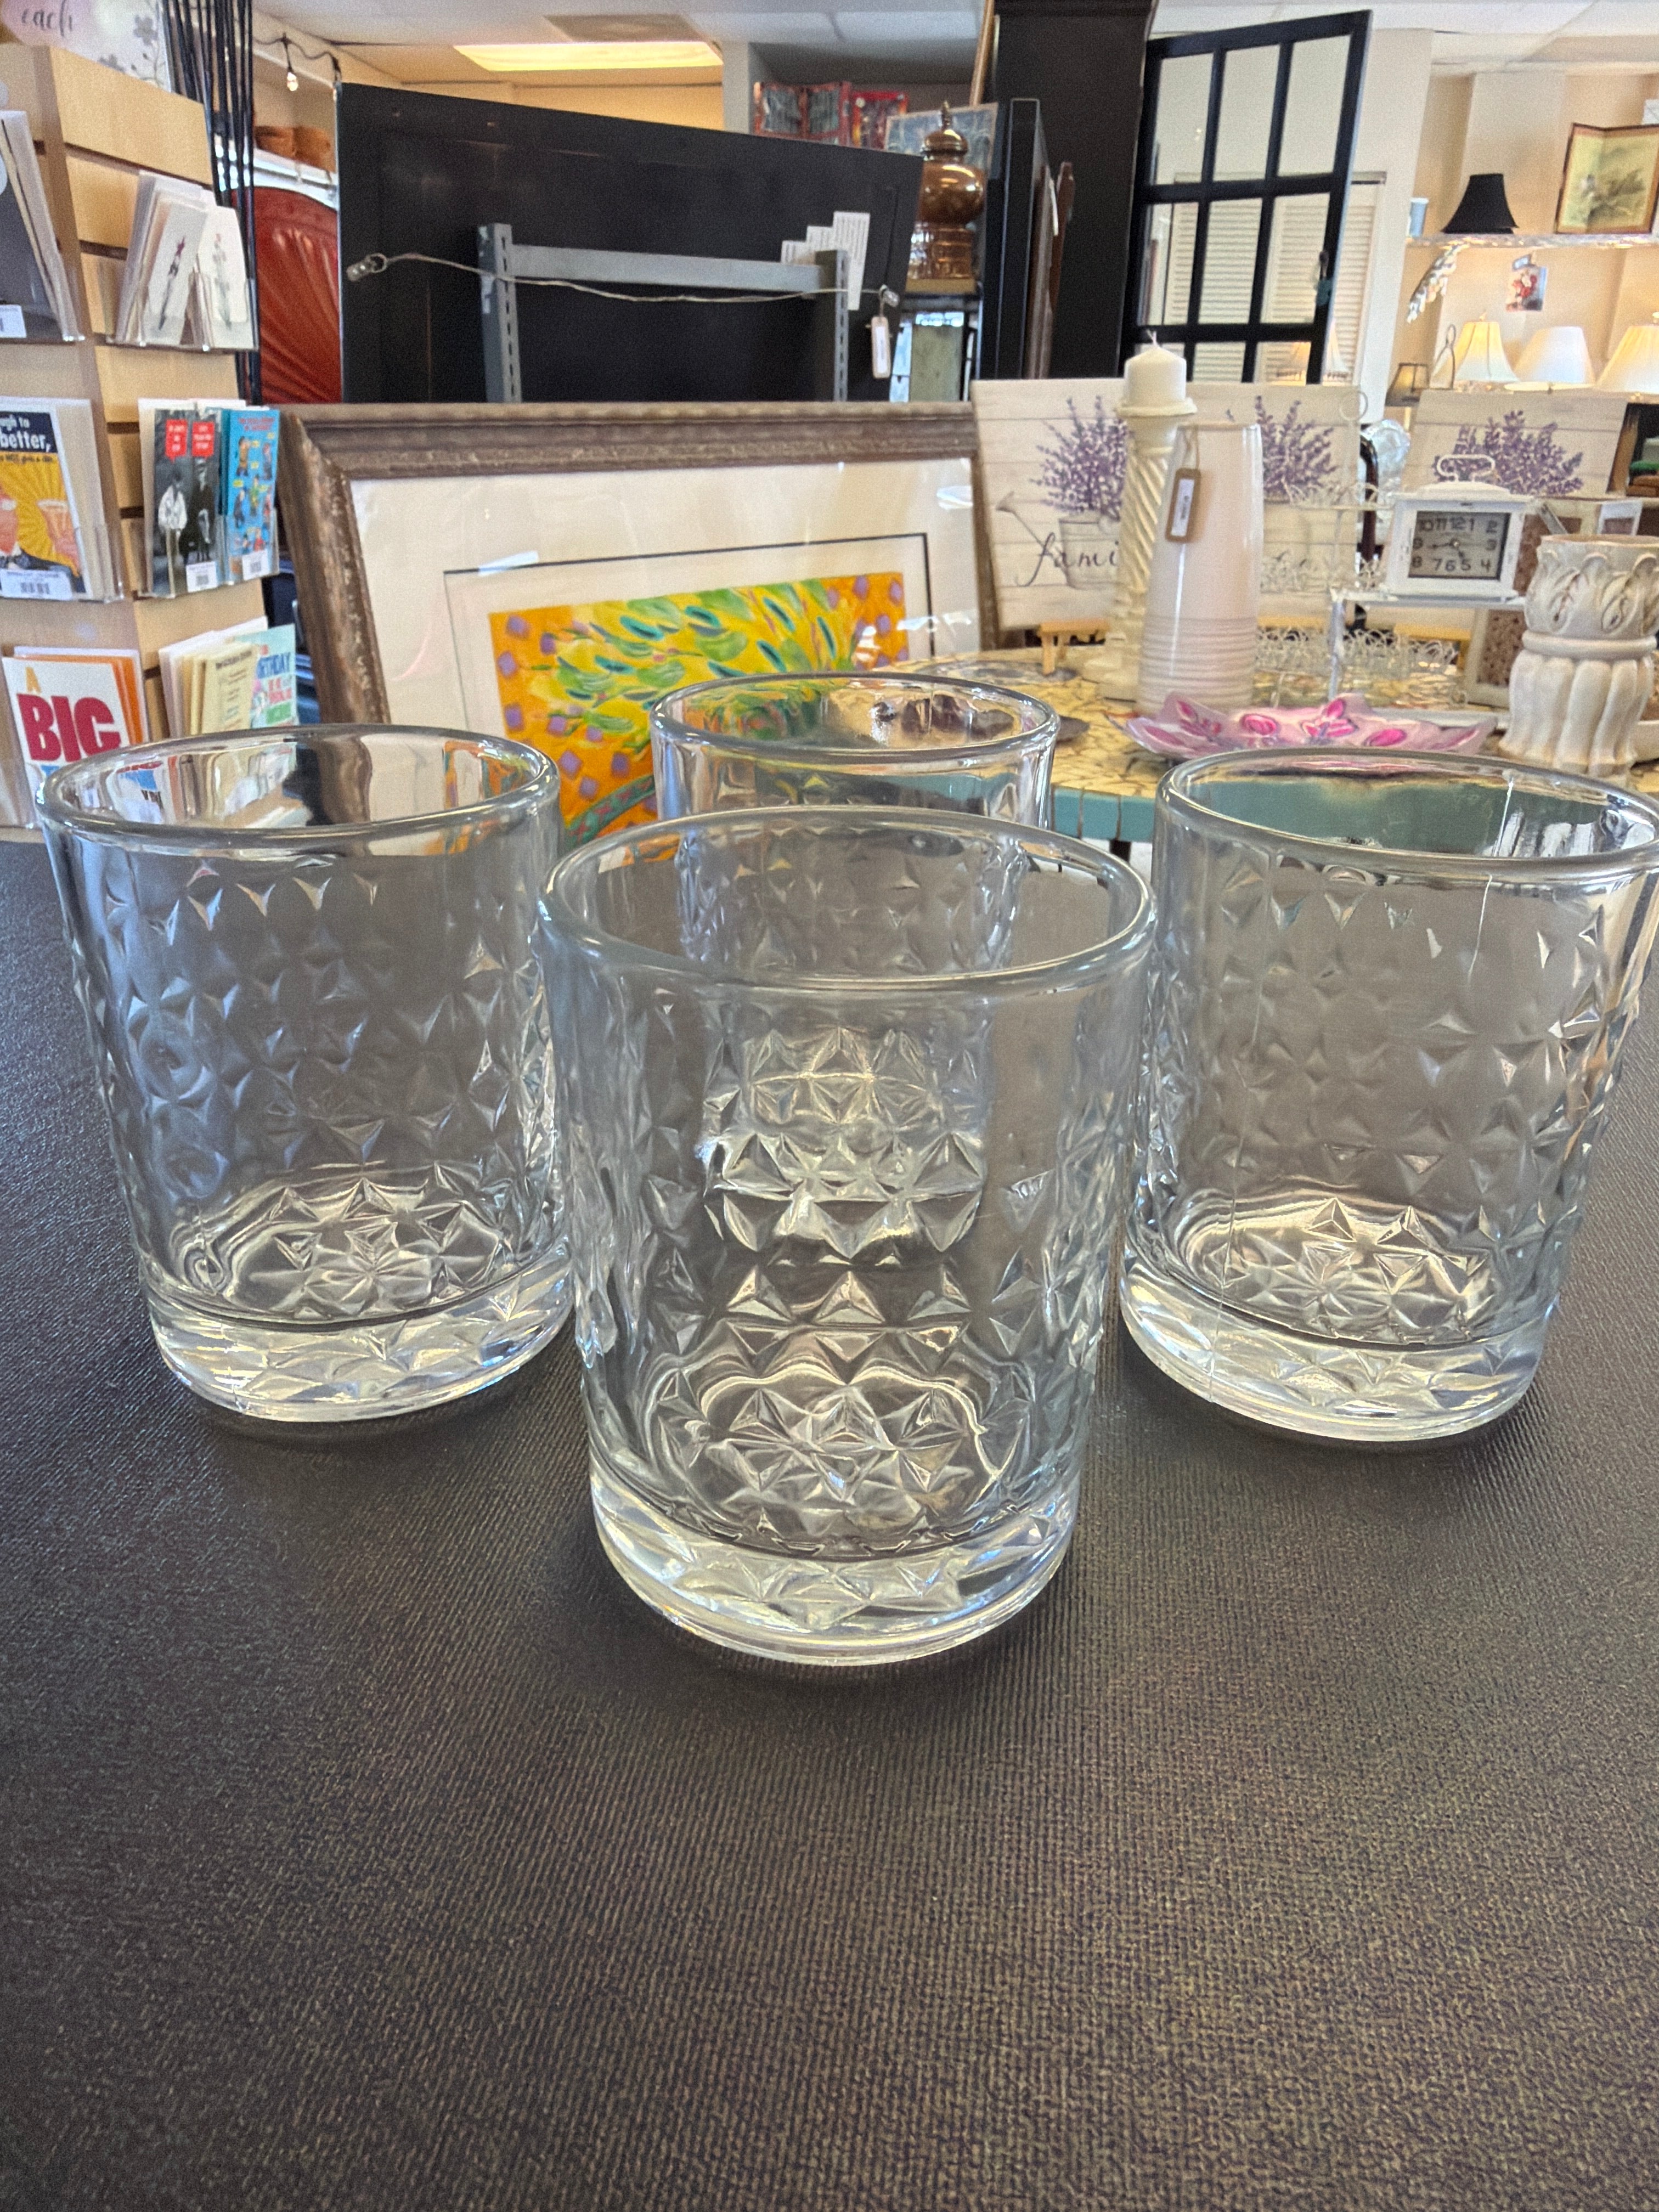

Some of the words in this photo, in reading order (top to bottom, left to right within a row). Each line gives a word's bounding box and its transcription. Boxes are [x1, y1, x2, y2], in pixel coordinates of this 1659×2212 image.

[1412, 556, 1423, 568] 8
[1433, 558, 1442, 571] 7
[1445, 560, 1456, 572] 6
[1460, 558, 1471, 571] 5
[1481, 558, 1491, 572] 4
[25, 666, 42, 694] A
[16, 693, 122, 763] BIG
